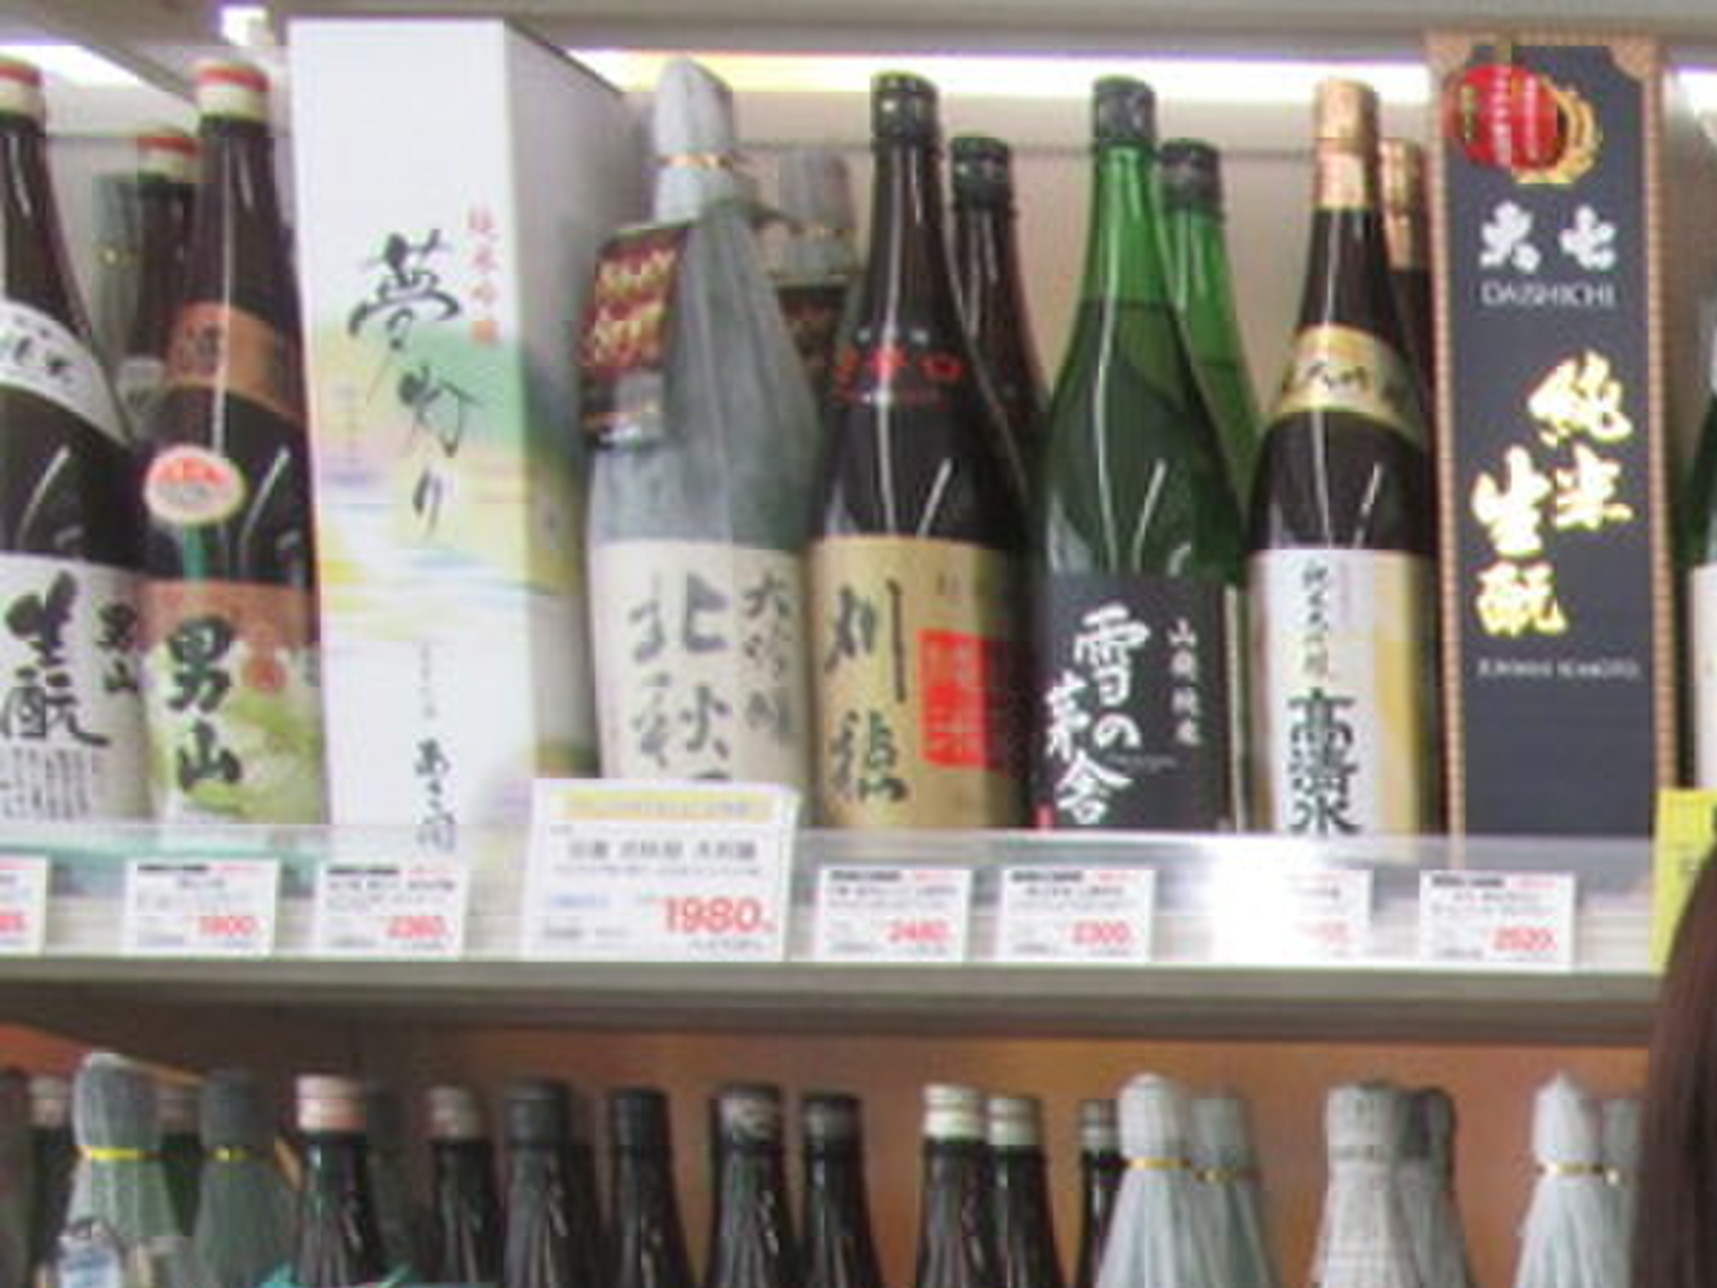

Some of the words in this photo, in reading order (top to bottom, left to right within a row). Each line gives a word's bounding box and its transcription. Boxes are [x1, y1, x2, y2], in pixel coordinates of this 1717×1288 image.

[1482, 281, 1616, 309] DAISHICHI
[166, 614, 243, 794] 男山
[662, 896, 761, 936] 1980
